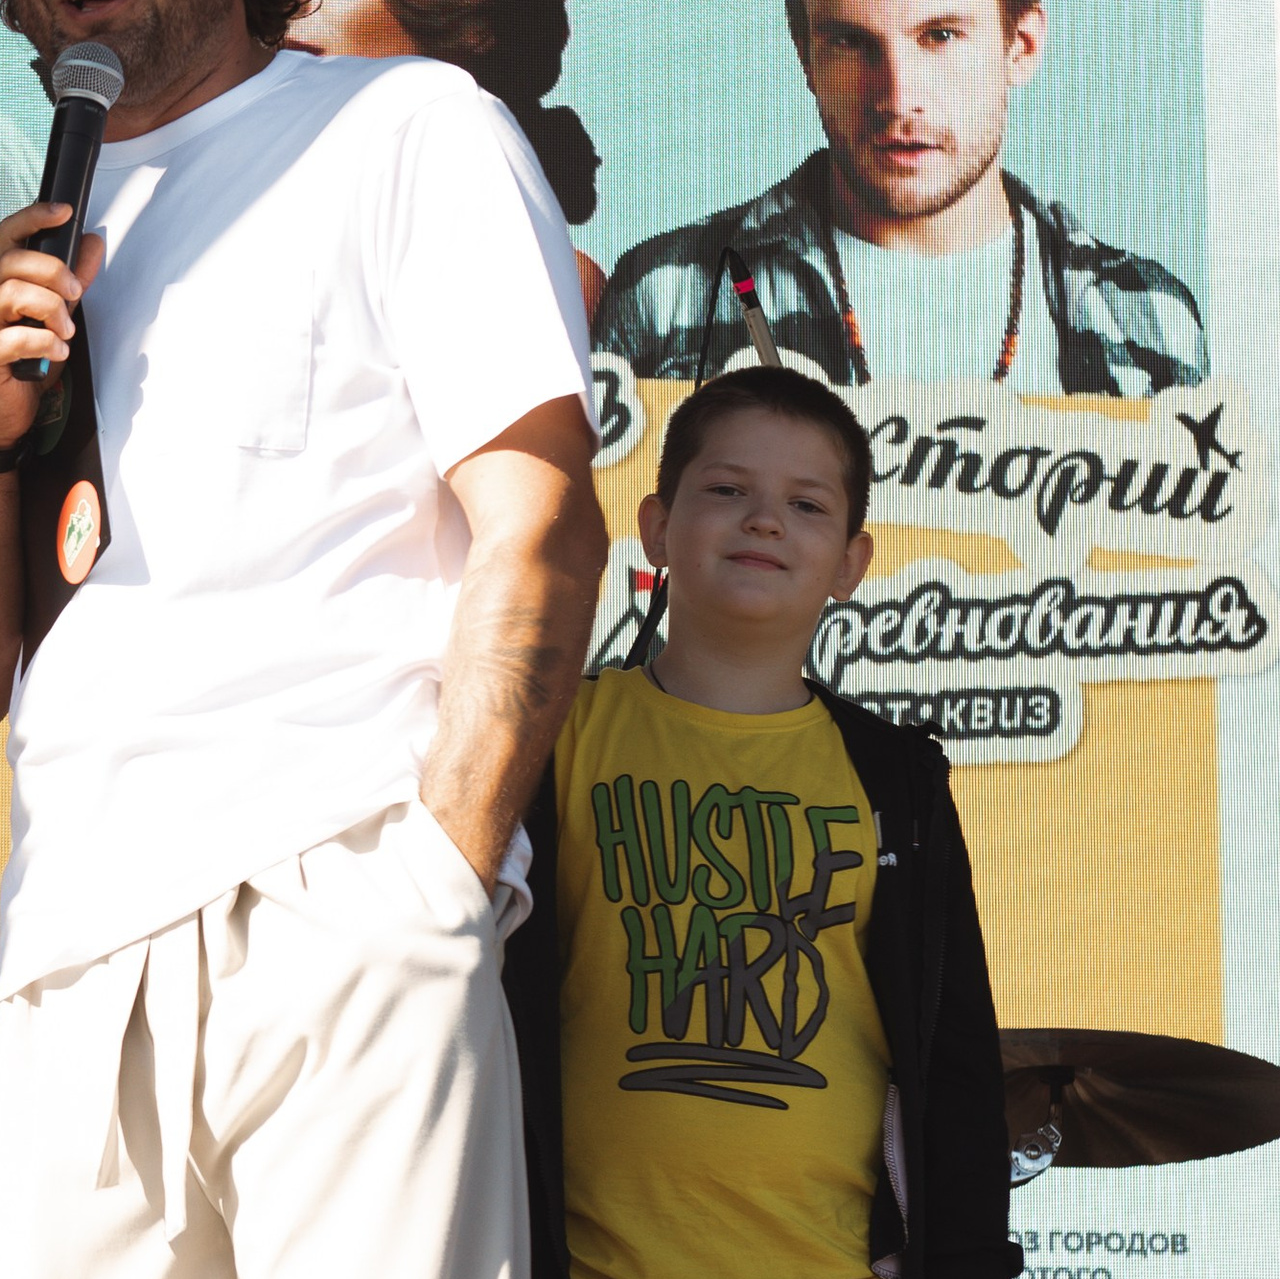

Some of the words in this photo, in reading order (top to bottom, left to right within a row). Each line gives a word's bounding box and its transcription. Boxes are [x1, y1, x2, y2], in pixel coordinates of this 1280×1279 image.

[591, 773, 864, 941] HUSTLE
[619, 902, 830, 1060] HARD
[1049, 1231, 1188, 1257] ГОРОДОВ
